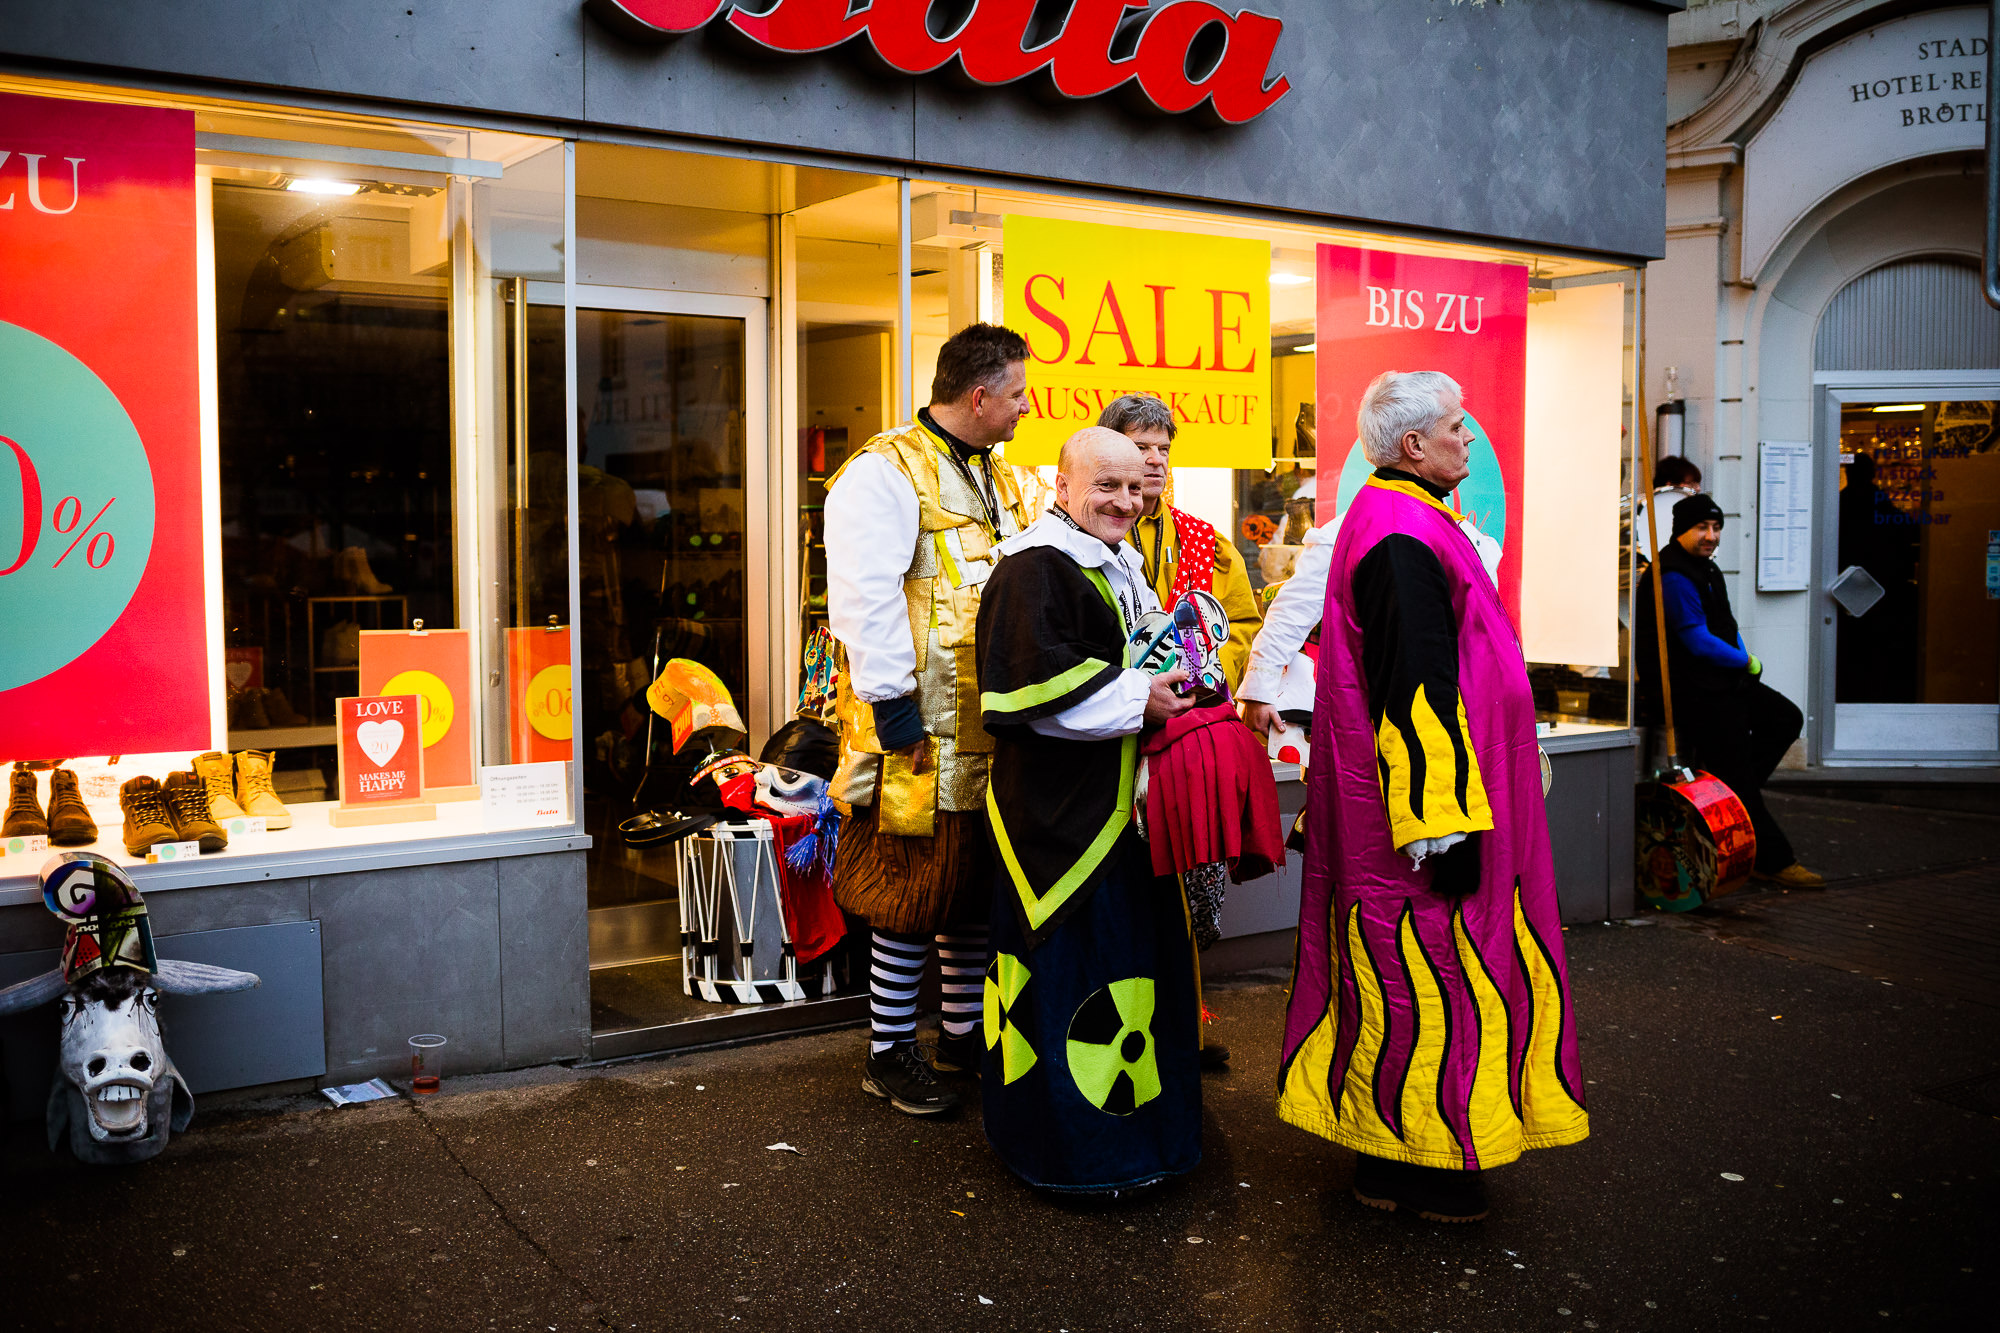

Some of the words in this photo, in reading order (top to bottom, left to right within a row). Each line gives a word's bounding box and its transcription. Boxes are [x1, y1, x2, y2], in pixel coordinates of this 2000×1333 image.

[1918, 38, 1988, 61] STAD
[1365, 285, 1425, 330] BIS
[1434, 292, 1485, 335] ZU
[1024, 273, 1256, 373] SALE
[1019, 386, 1258, 425] AUSVKAUF
[356, 700, 404, 718] LOVE
[359, 771, 391, 782] MAKES
[391, 770, 406, 779] ME
[359, 778, 406, 792] HAPPY
